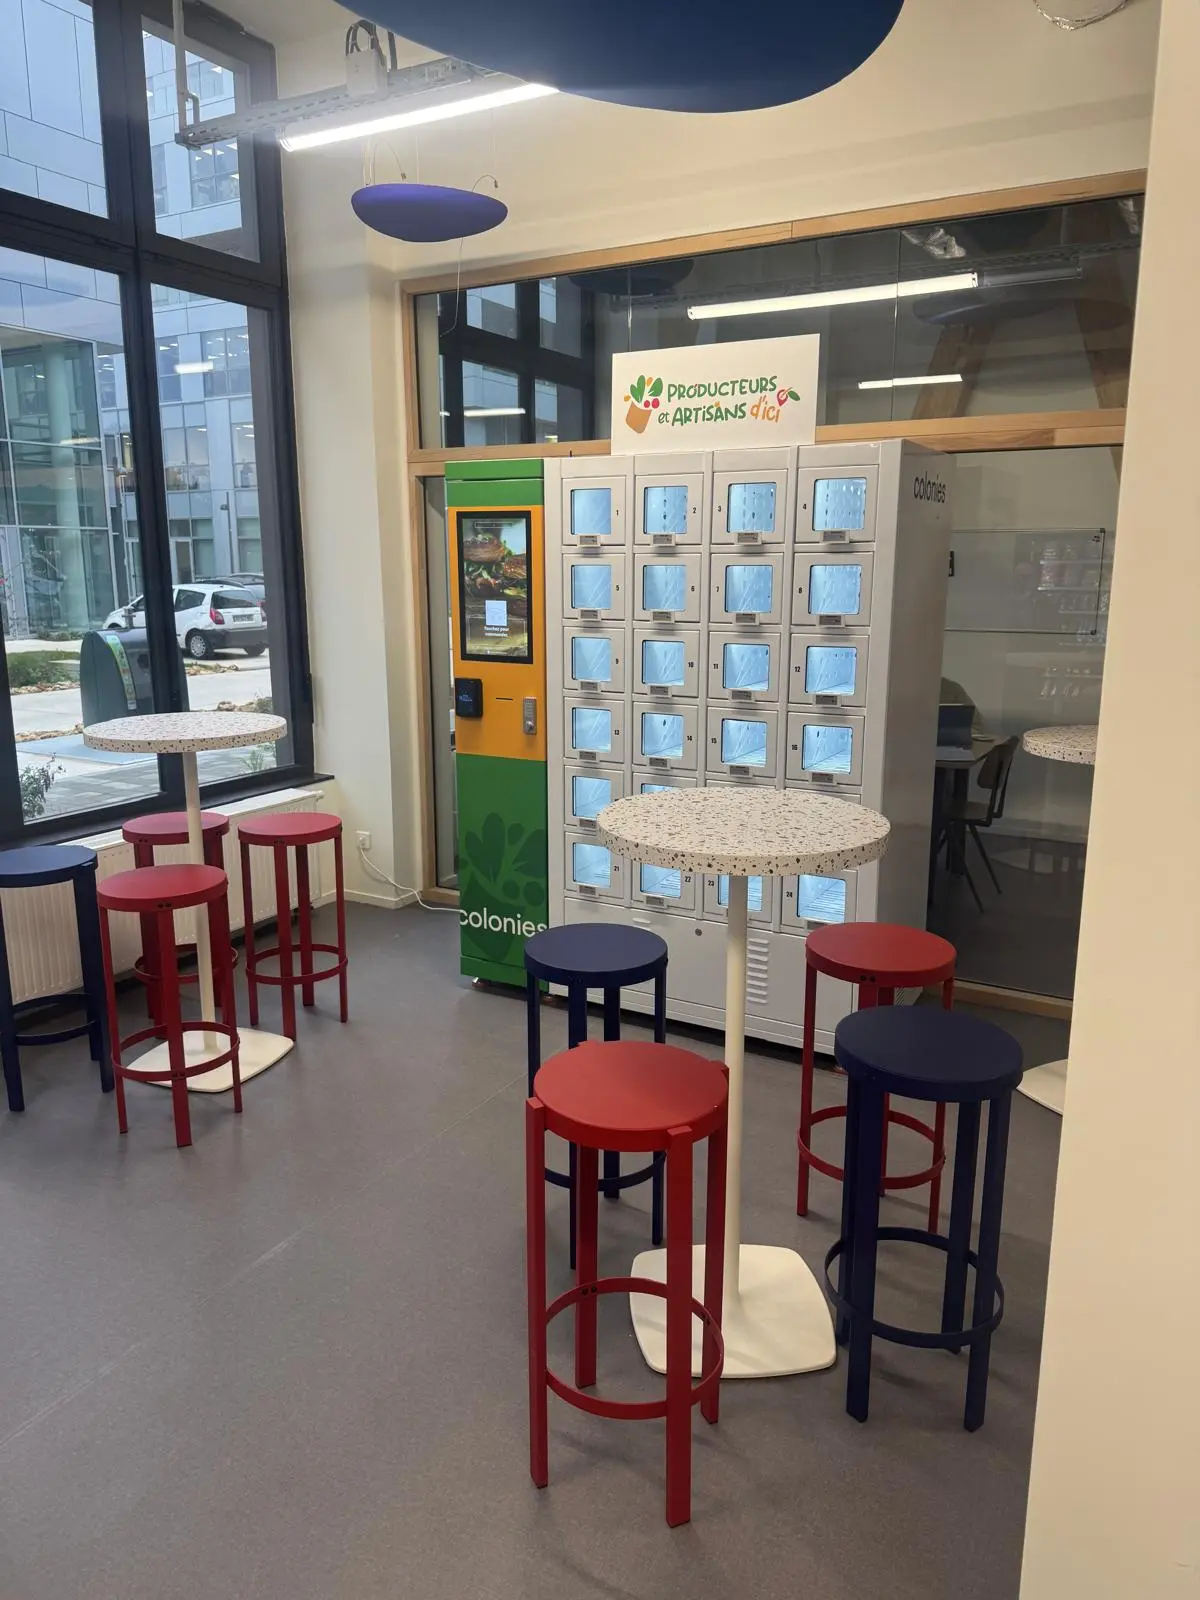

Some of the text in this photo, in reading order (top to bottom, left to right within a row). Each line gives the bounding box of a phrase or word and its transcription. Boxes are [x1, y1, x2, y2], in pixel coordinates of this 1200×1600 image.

[667, 375, 778, 402] PRODUCTEURS
[657, 411, 670, 424] et
[913, 470, 946, 504] colonies
